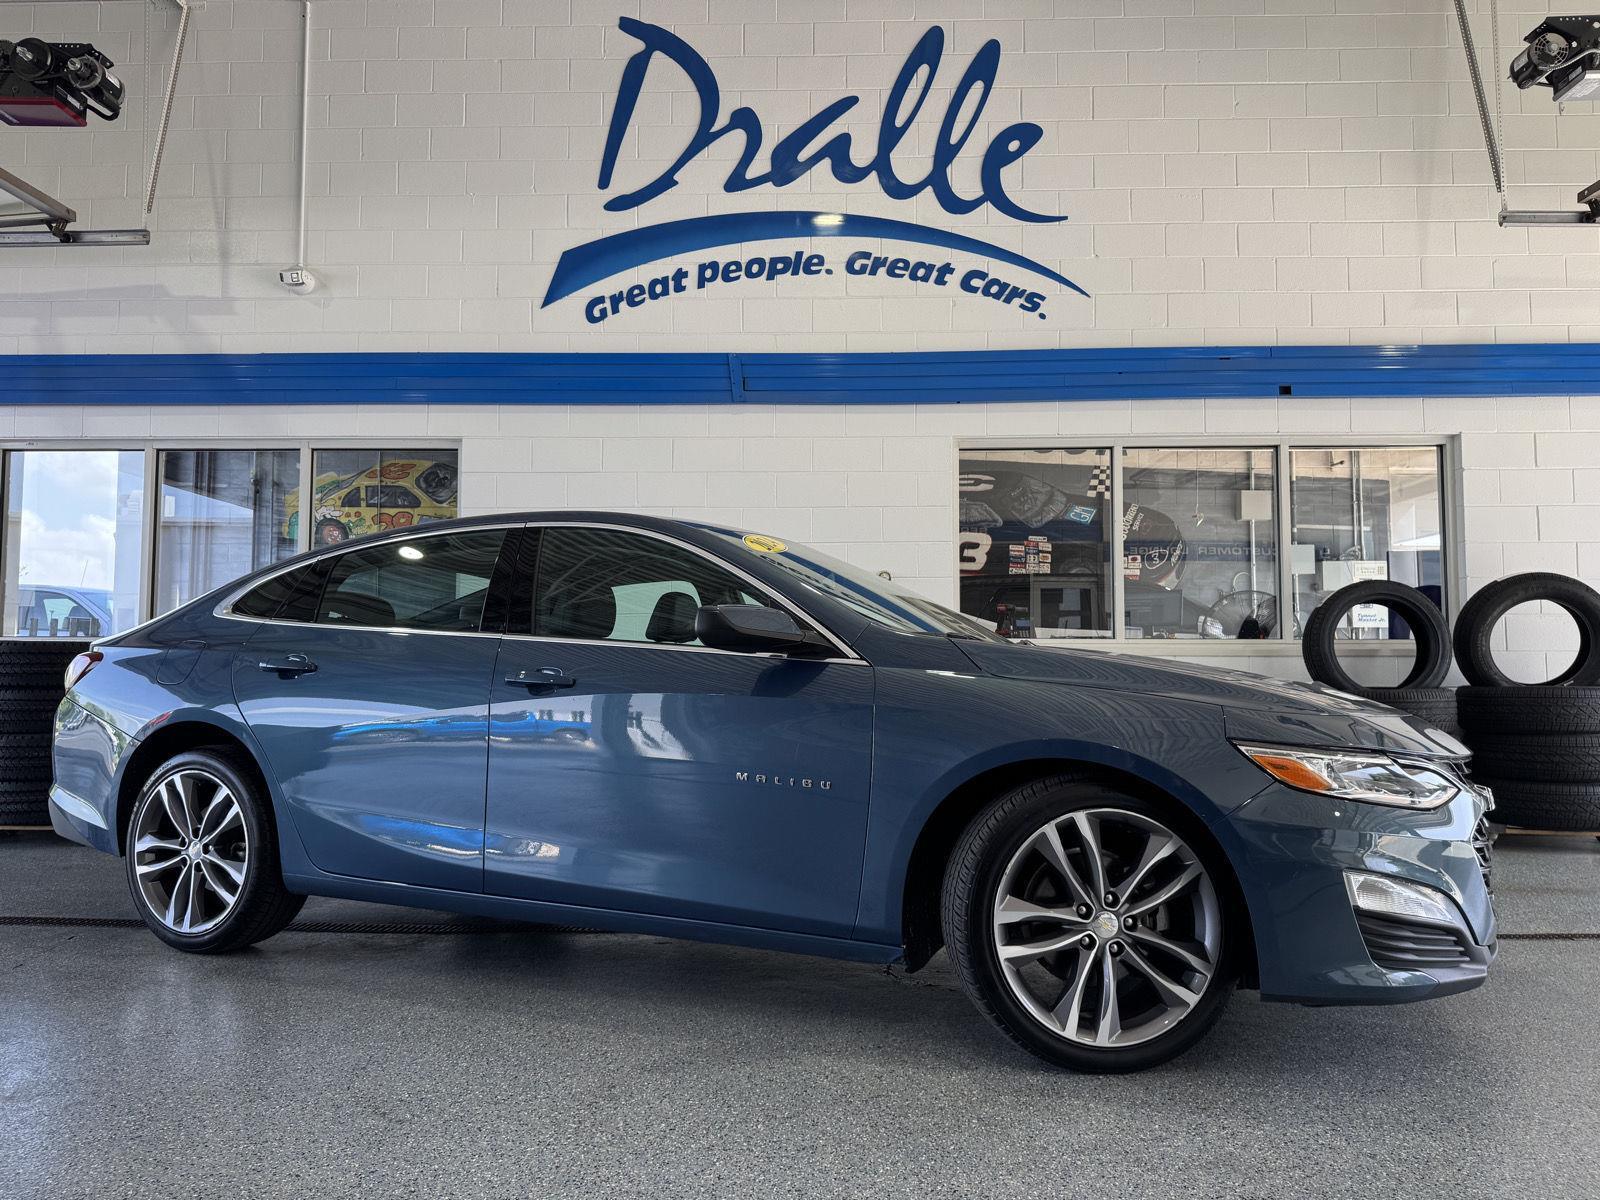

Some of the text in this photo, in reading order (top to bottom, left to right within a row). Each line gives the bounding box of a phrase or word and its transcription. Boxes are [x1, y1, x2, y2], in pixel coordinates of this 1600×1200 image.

[598, 16, 1068, 223] Dralle
[584, 251, 1048, 324] Great people. Great Cars.
[736, 772, 831, 790] MALIBU
